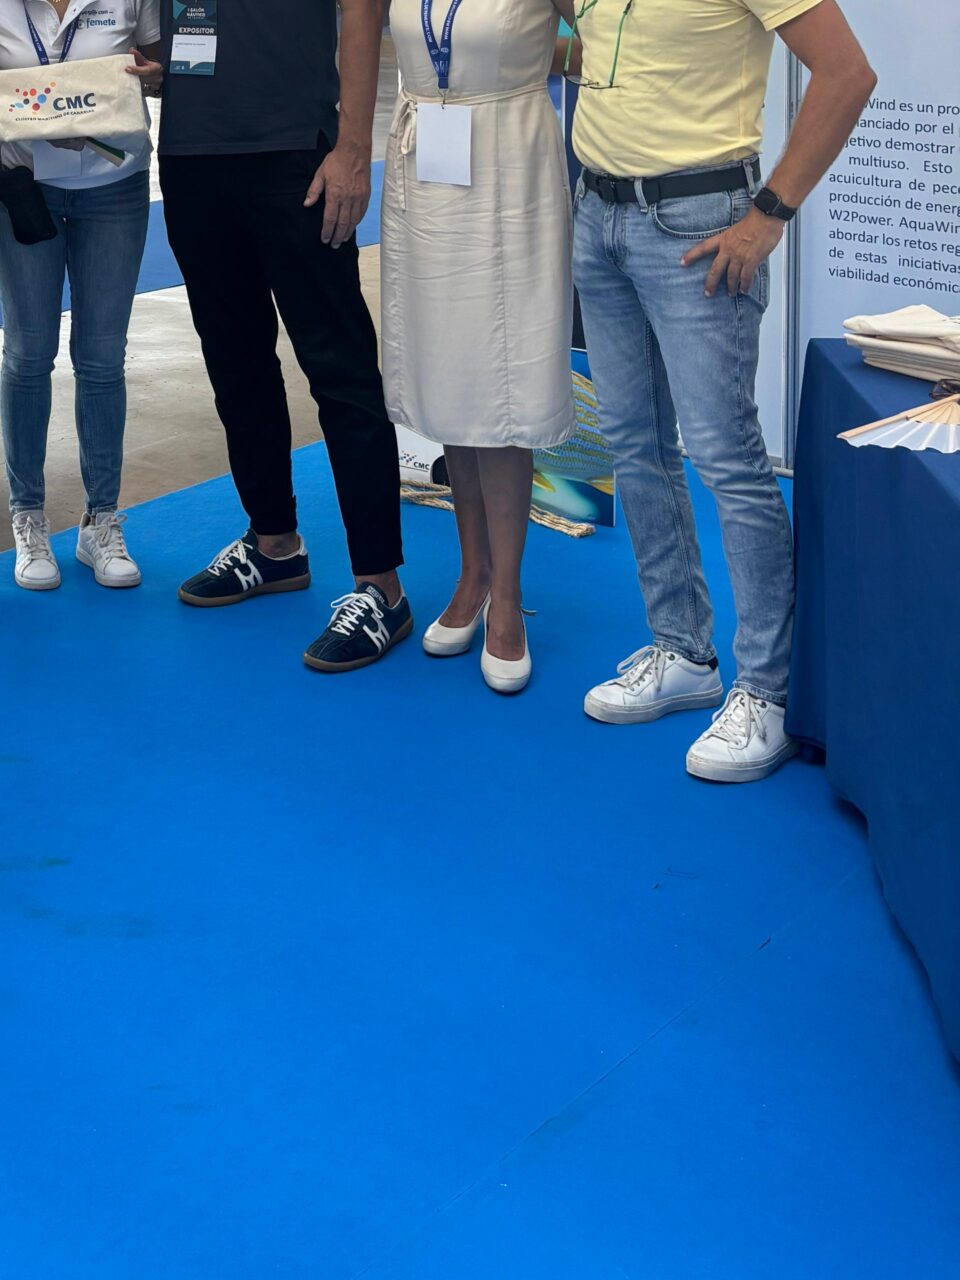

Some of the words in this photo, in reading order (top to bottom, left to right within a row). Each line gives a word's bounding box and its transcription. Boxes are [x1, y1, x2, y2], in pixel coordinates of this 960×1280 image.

[86, 18, 116, 29] femete
[53, 92, 97, 111] CMC
[899, 102, 914, 112] es
[917, 103, 934, 114] un
[937, 105, 960, 117] pro
[915, 123, 938, 135] por
[942, 123, 954, 135] el
[885, 137, 956, 155] demostrar
[848, 155, 910, 171] multiuso.
[923, 160, 953, 174] Esto
[829, 172, 902, 189] acuicultura
[908, 178, 926, 192] de
[932, 183, 960, 195] pec
[829, 192, 901, 209] producción
[905, 197, 922, 211] de
[829, 208, 894, 227] W2Power.
[829, 228, 879, 244] abordar
[882, 233, 900, 247] los
[904, 238, 938, 252] retos
[828, 246, 845, 259] de
[855, 251, 888, 265] estas
[828, 266, 889, 284] viabilidad
[893, 276, 960, 294] económic
[413, 461, 430, 471] CMC
